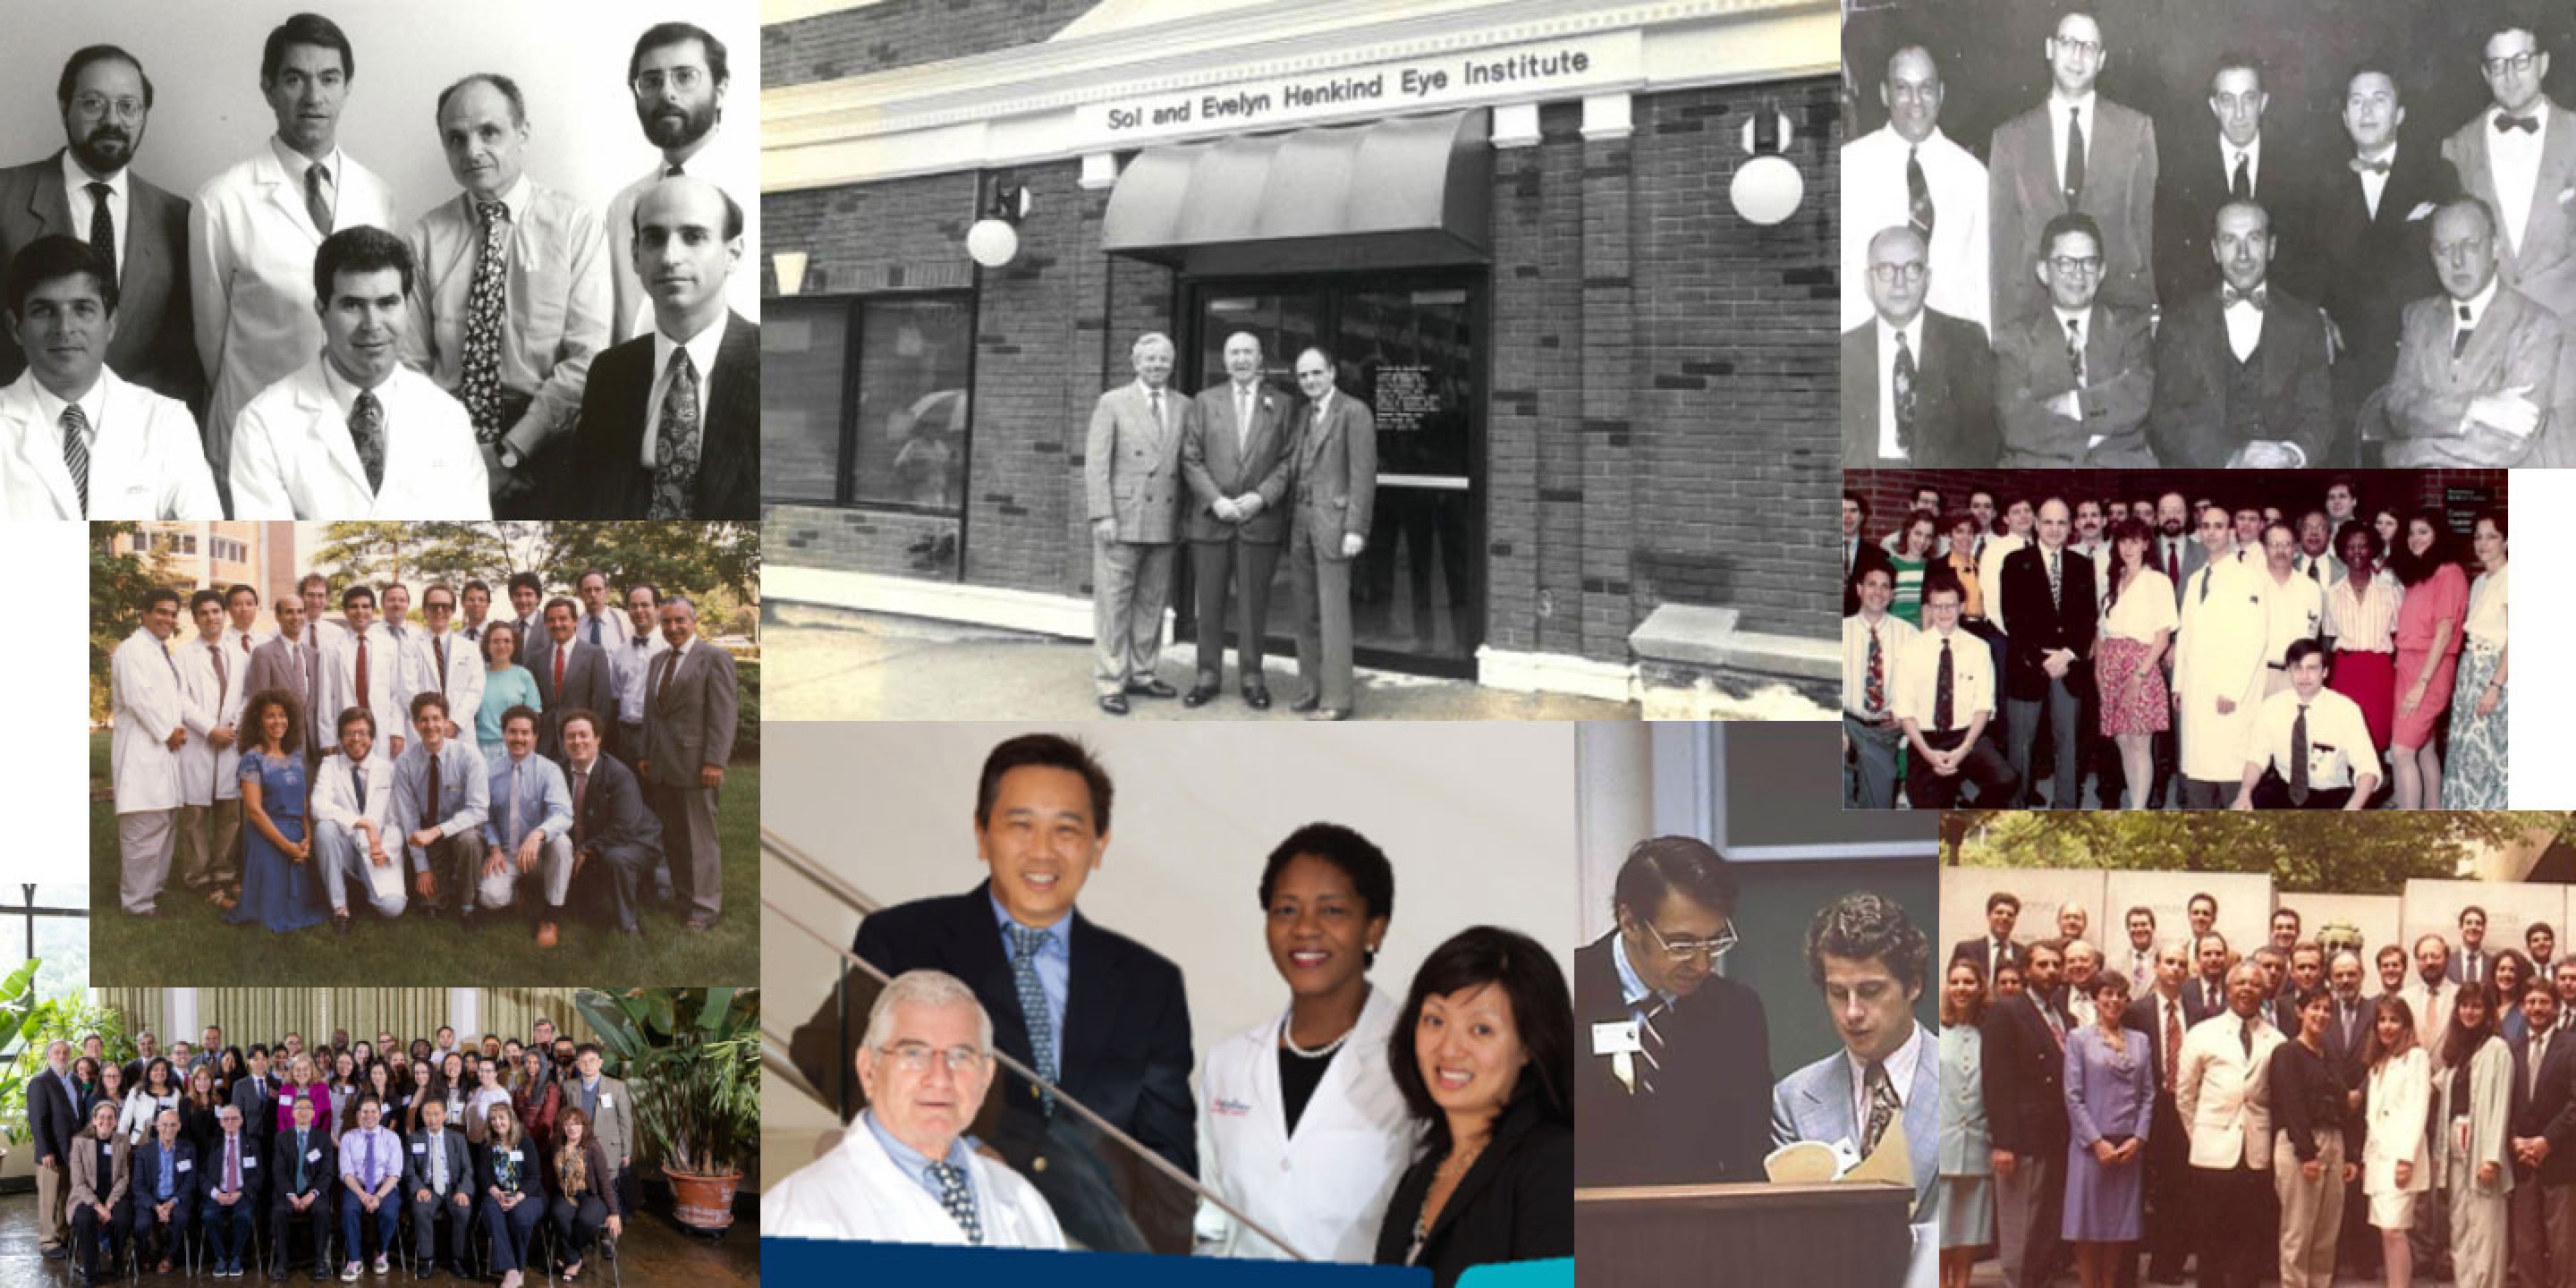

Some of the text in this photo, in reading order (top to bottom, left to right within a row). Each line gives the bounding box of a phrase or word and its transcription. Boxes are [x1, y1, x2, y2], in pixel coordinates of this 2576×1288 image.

[1107, 50, 1589, 130] Sol and Evelyn Henkind Eye Institute
